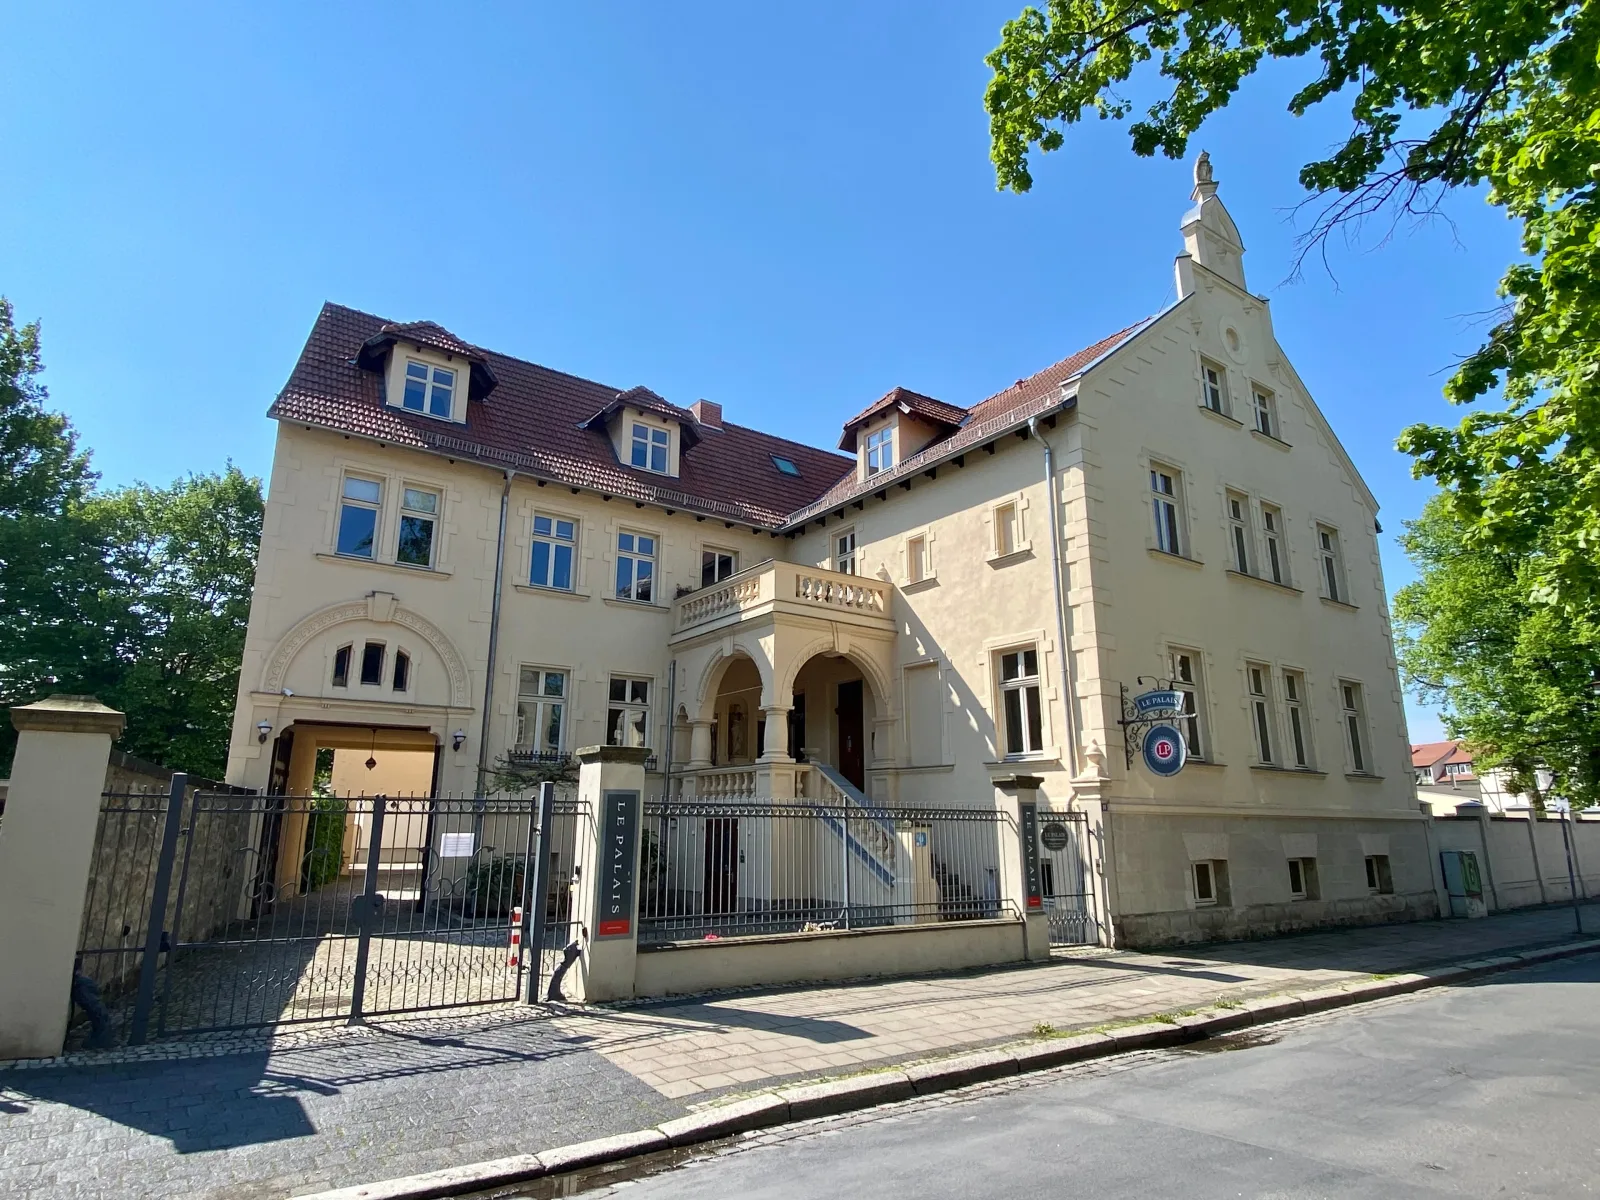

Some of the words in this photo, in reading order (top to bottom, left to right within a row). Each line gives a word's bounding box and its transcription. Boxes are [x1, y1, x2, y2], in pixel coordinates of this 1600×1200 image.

[1141, 699, 1151, 707] LE
[1152, 696, 1178, 704] PALAIS
[1158, 744, 1171, 755] LP
[616, 801, 626, 826] LE
[1026, 811, 1032, 829] LE
[611, 834, 624, 914] PALAIS
[1027, 835, 1036, 892] PALAIS
